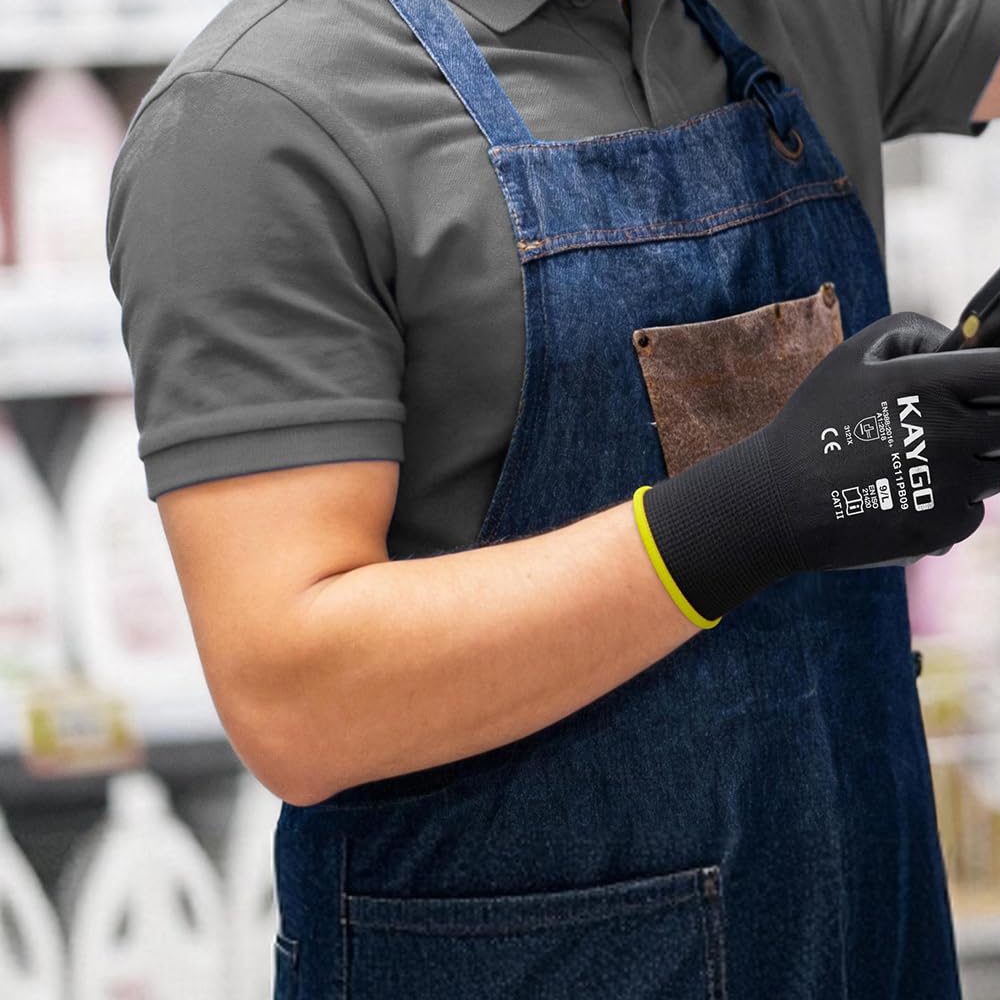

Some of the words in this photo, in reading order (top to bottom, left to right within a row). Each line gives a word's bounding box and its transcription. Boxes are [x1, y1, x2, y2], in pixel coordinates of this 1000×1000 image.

[844, 425, 854, 445] 3121X
[897, 395, 934, 511] KAYGO
[891, 453, 909, 510] KG11PB09
[831, 491, 842, 510] CAT
[878, 485, 889, 504] 9/L
